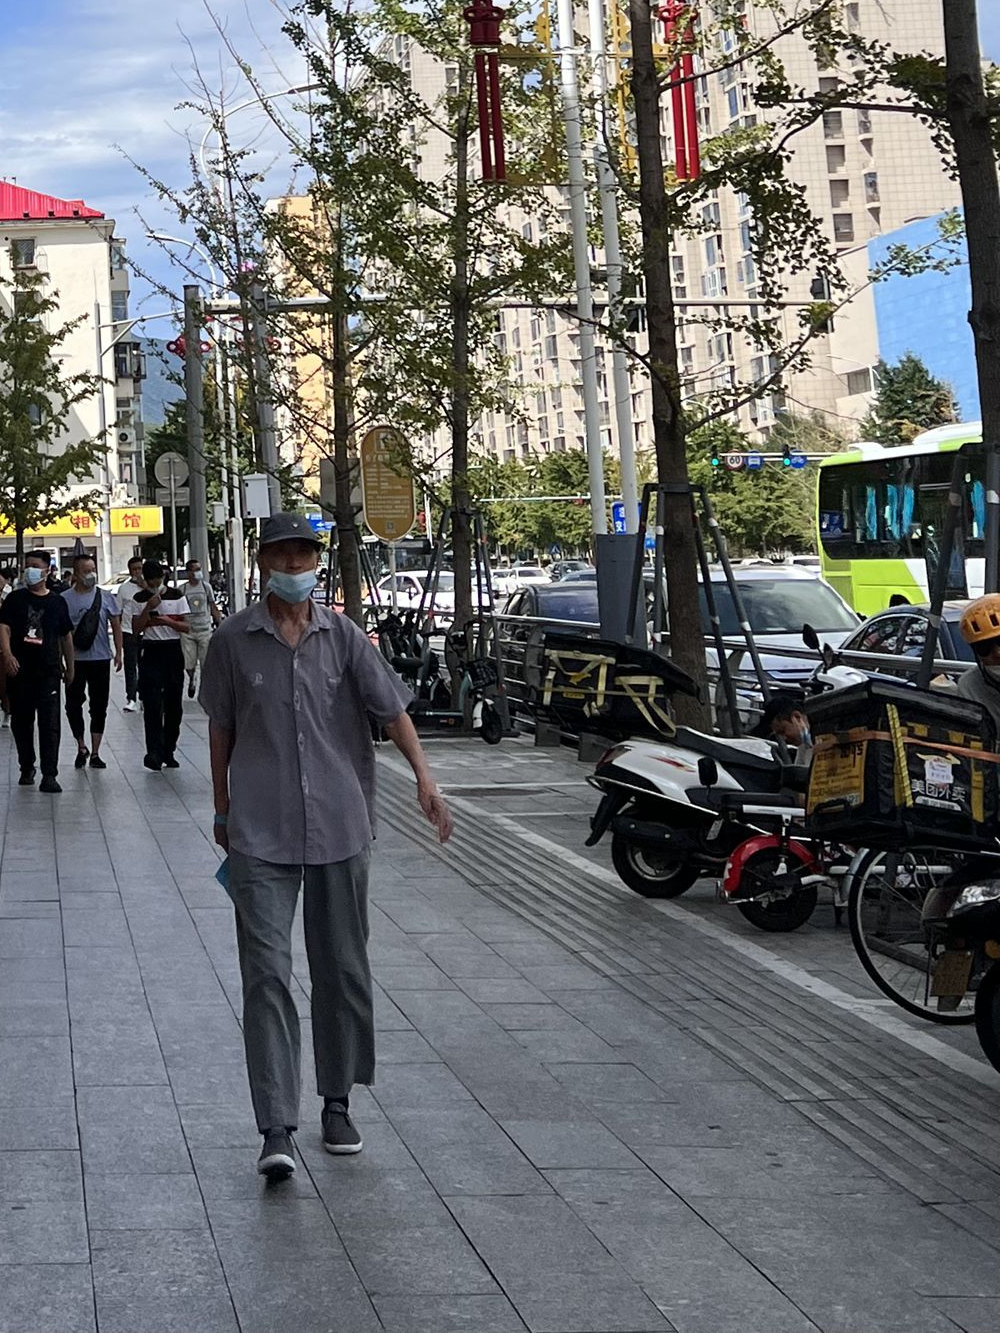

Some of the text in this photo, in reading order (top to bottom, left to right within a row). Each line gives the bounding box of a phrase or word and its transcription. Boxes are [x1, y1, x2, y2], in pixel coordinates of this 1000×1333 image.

[729, 455, 740, 465] 60
[911, 779, 966, 803] 美团外卖
